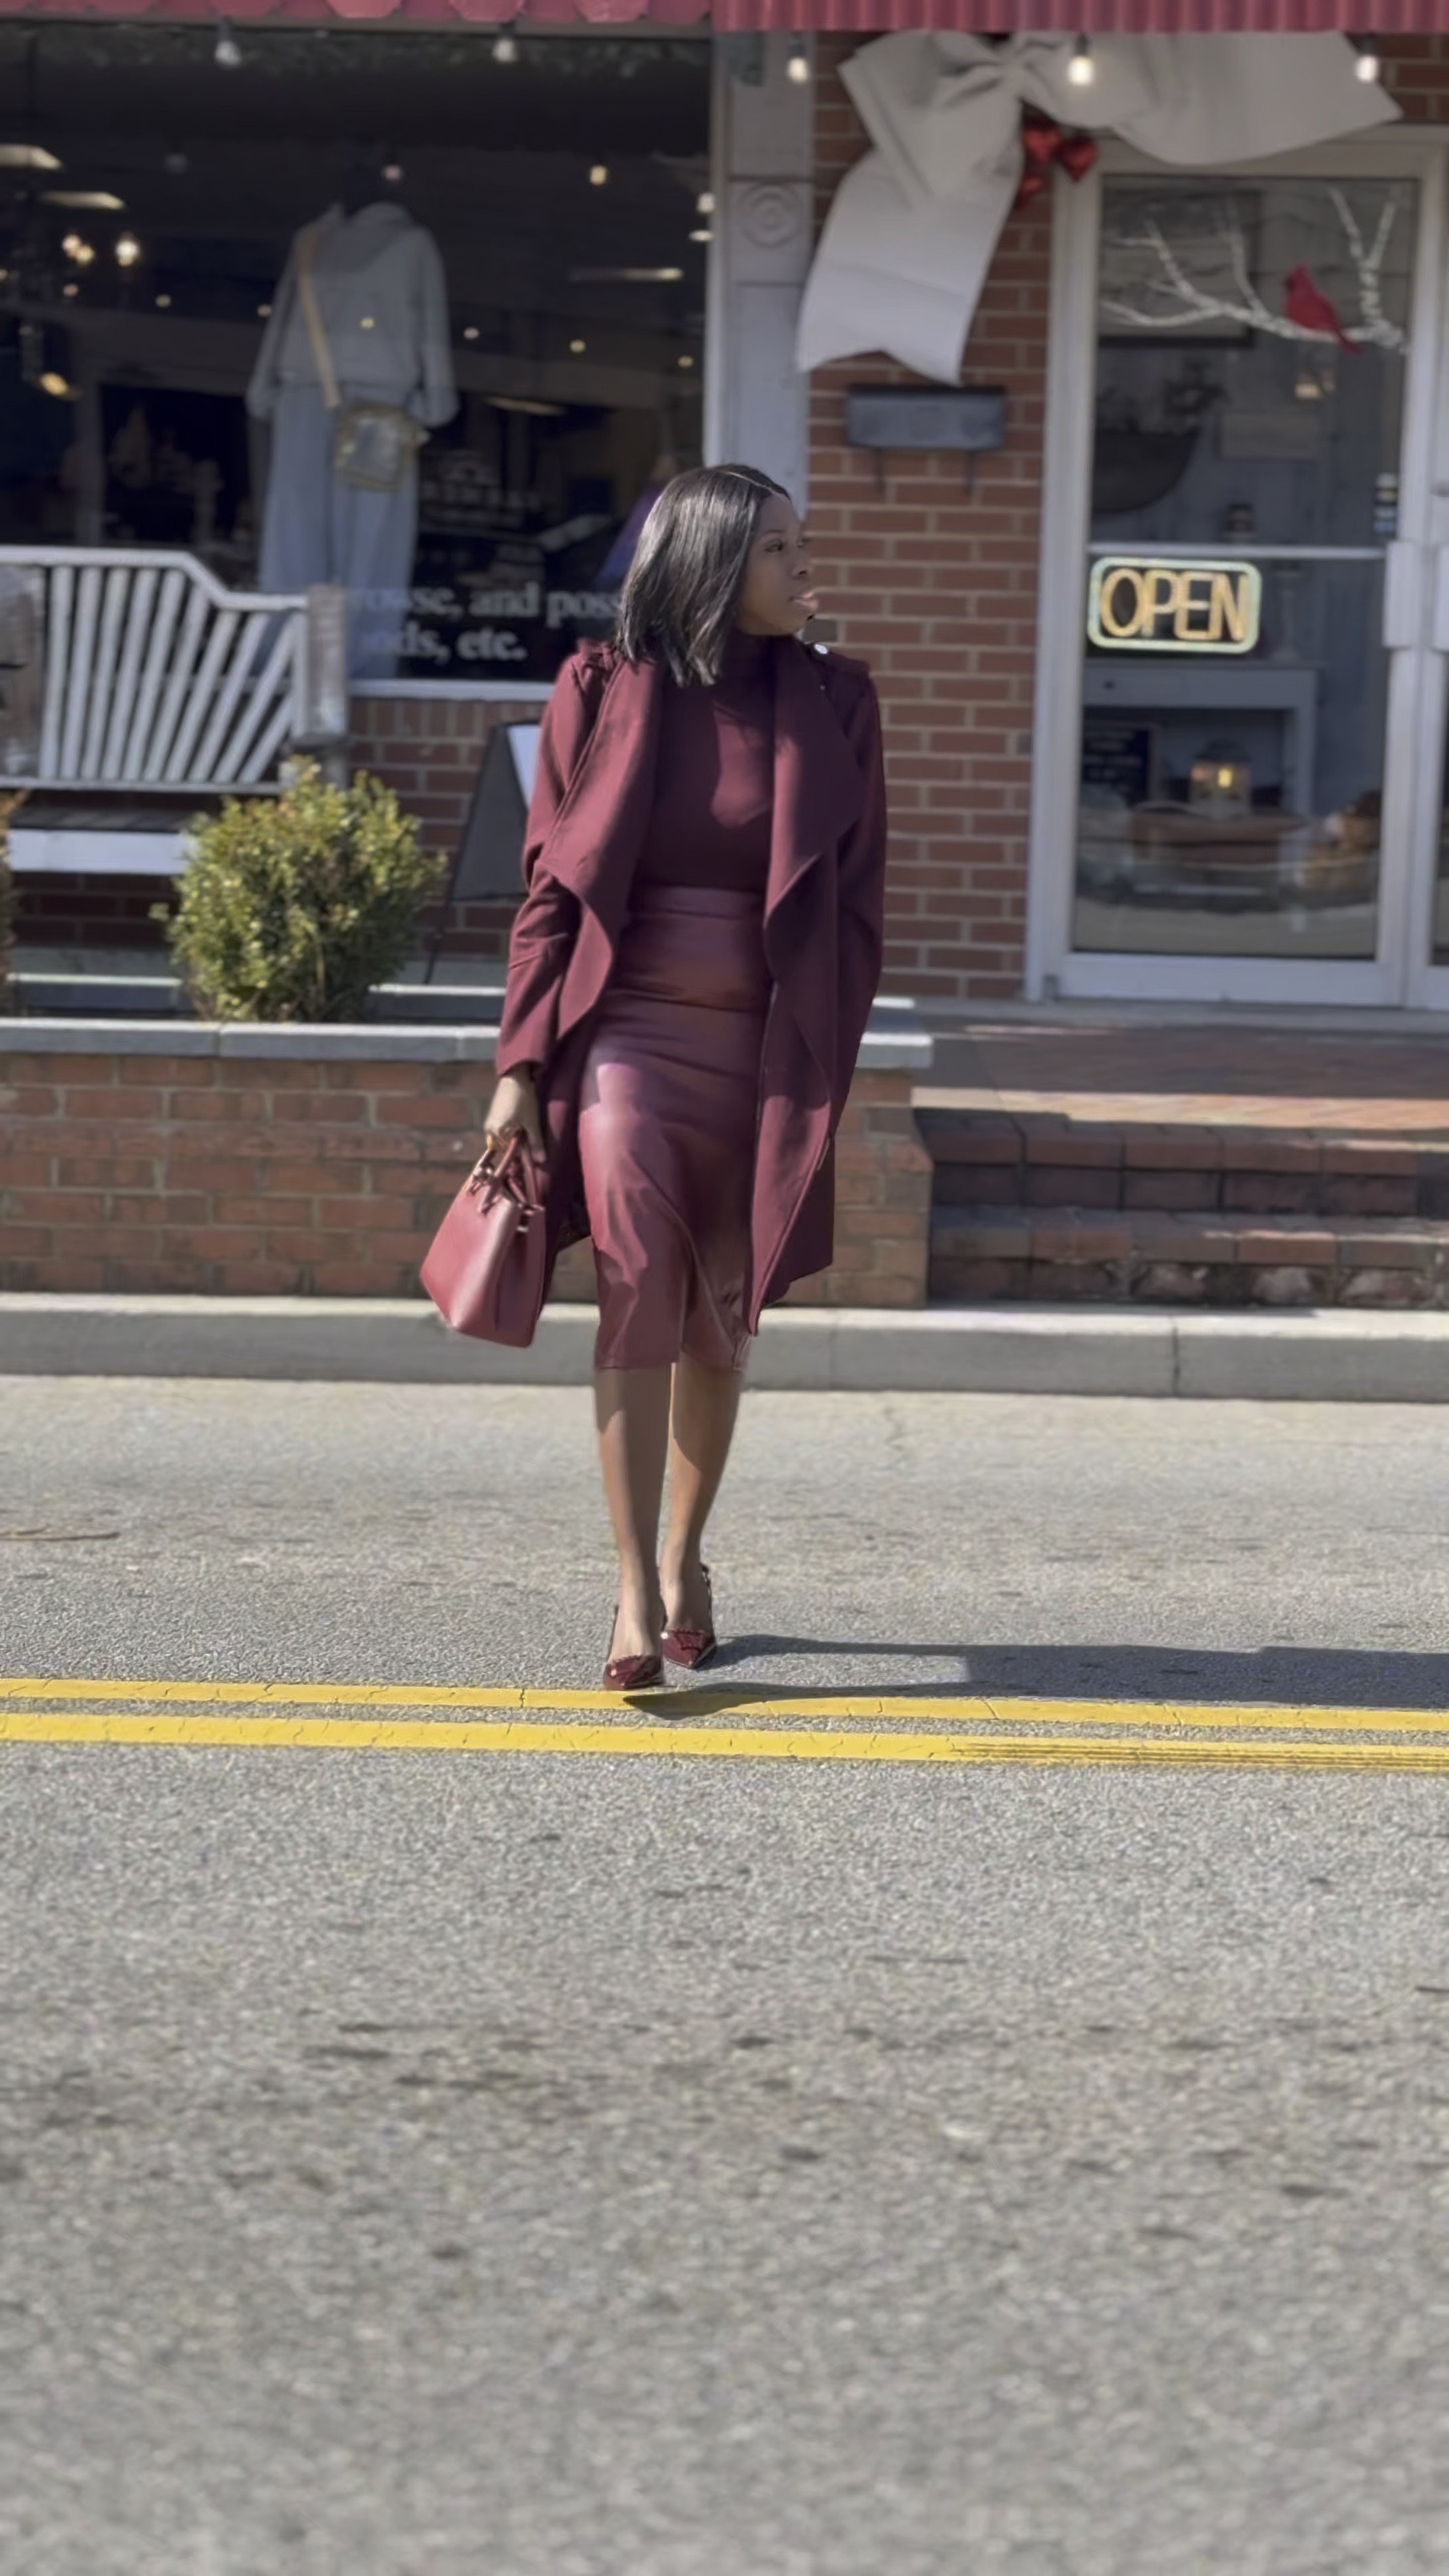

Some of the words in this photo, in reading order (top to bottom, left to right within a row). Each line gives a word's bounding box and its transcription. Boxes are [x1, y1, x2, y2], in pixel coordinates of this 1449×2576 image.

[470, 581, 539, 616] and
[1100, 568, 1248, 642] OPEN
[457, 627, 527, 660] etc.
